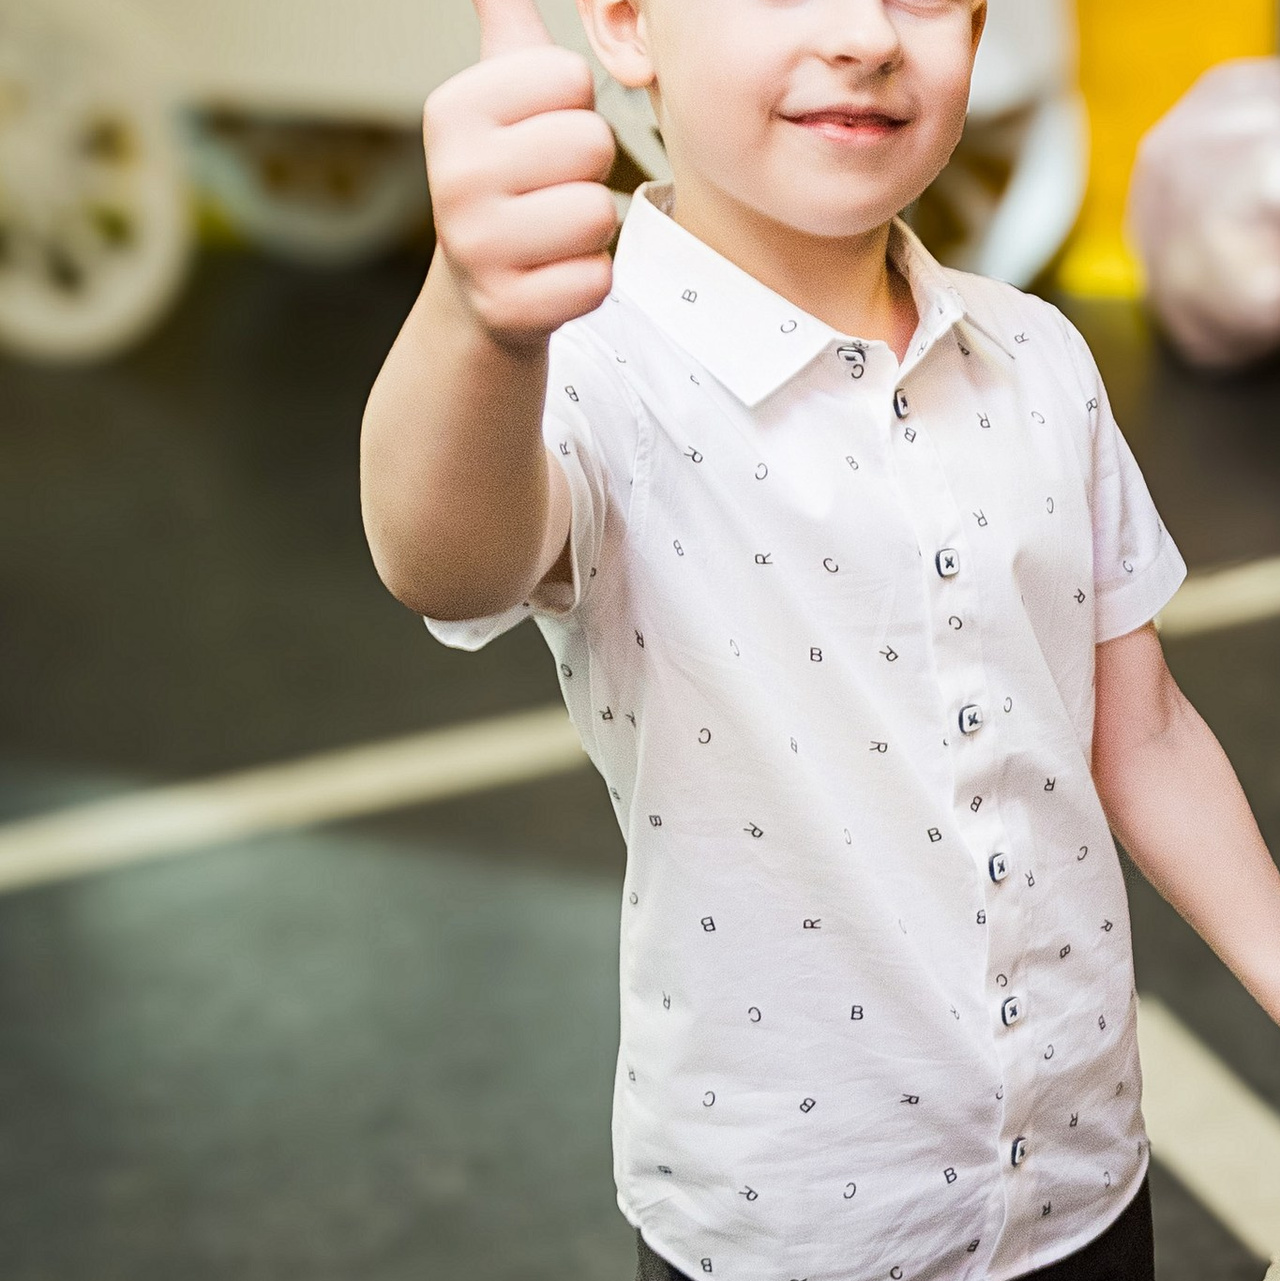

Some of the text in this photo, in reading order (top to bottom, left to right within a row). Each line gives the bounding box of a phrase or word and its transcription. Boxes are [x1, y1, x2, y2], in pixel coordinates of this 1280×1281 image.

[681, 288, 698, 303] B
[780, 320, 797, 334] C
[1014, 332, 1029, 344] R
[851, 363, 865, 380] C
[565, 385, 580, 403] B
[976, 412, 991, 429] R
[1031, 411, 1046, 424] C
[904, 427, 917, 443] B
[559, 441, 571, 456] R
[683, 445, 704, 464] R
[846, 455, 859, 471] B
[755, 462, 769, 481] C
[972, 509, 988, 527] R
[754, 552, 773, 565] R
[822, 557, 839, 574] C
[1073, 588, 1086, 604] R
[948, 615, 963, 631] C
[809, 646, 823, 663] B
[878, 645, 899, 662] R
[1003, 696, 1013, 713] C
[600, 706, 614, 721] R
[698, 727, 712, 745] C
[868, 740, 888, 754] R
[1044, 776, 1056, 792] R
[970, 795, 983, 813] B
[649, 814, 663, 828] B
[743, 822, 764, 839] R
[927, 827, 943, 843] B
[1076, 845, 1088, 862] C
[1024, 870, 1035, 888] R
[700, 916, 716, 933] B
[802, 918, 821, 930] R
[1101, 919, 1114, 933] R
[1059, 944, 1071, 960] B
[995, 973, 1008, 988] C
[748, 1006, 762, 1023] C
[850, 1004, 864, 1021] B
[1043, 1044, 1055, 1060] C
[703, 1091, 716, 1107] C
[799, 1098, 817, 1114] B
[900, 1093, 920, 1106] R
[943, 1167, 958, 1184] B
[738, 1185, 759, 1202] R
[843, 1182, 857, 1200] C
[967, 1239, 981, 1253] B
[700, 1257, 713, 1274] B
[889, 1265, 903, 1281] C
